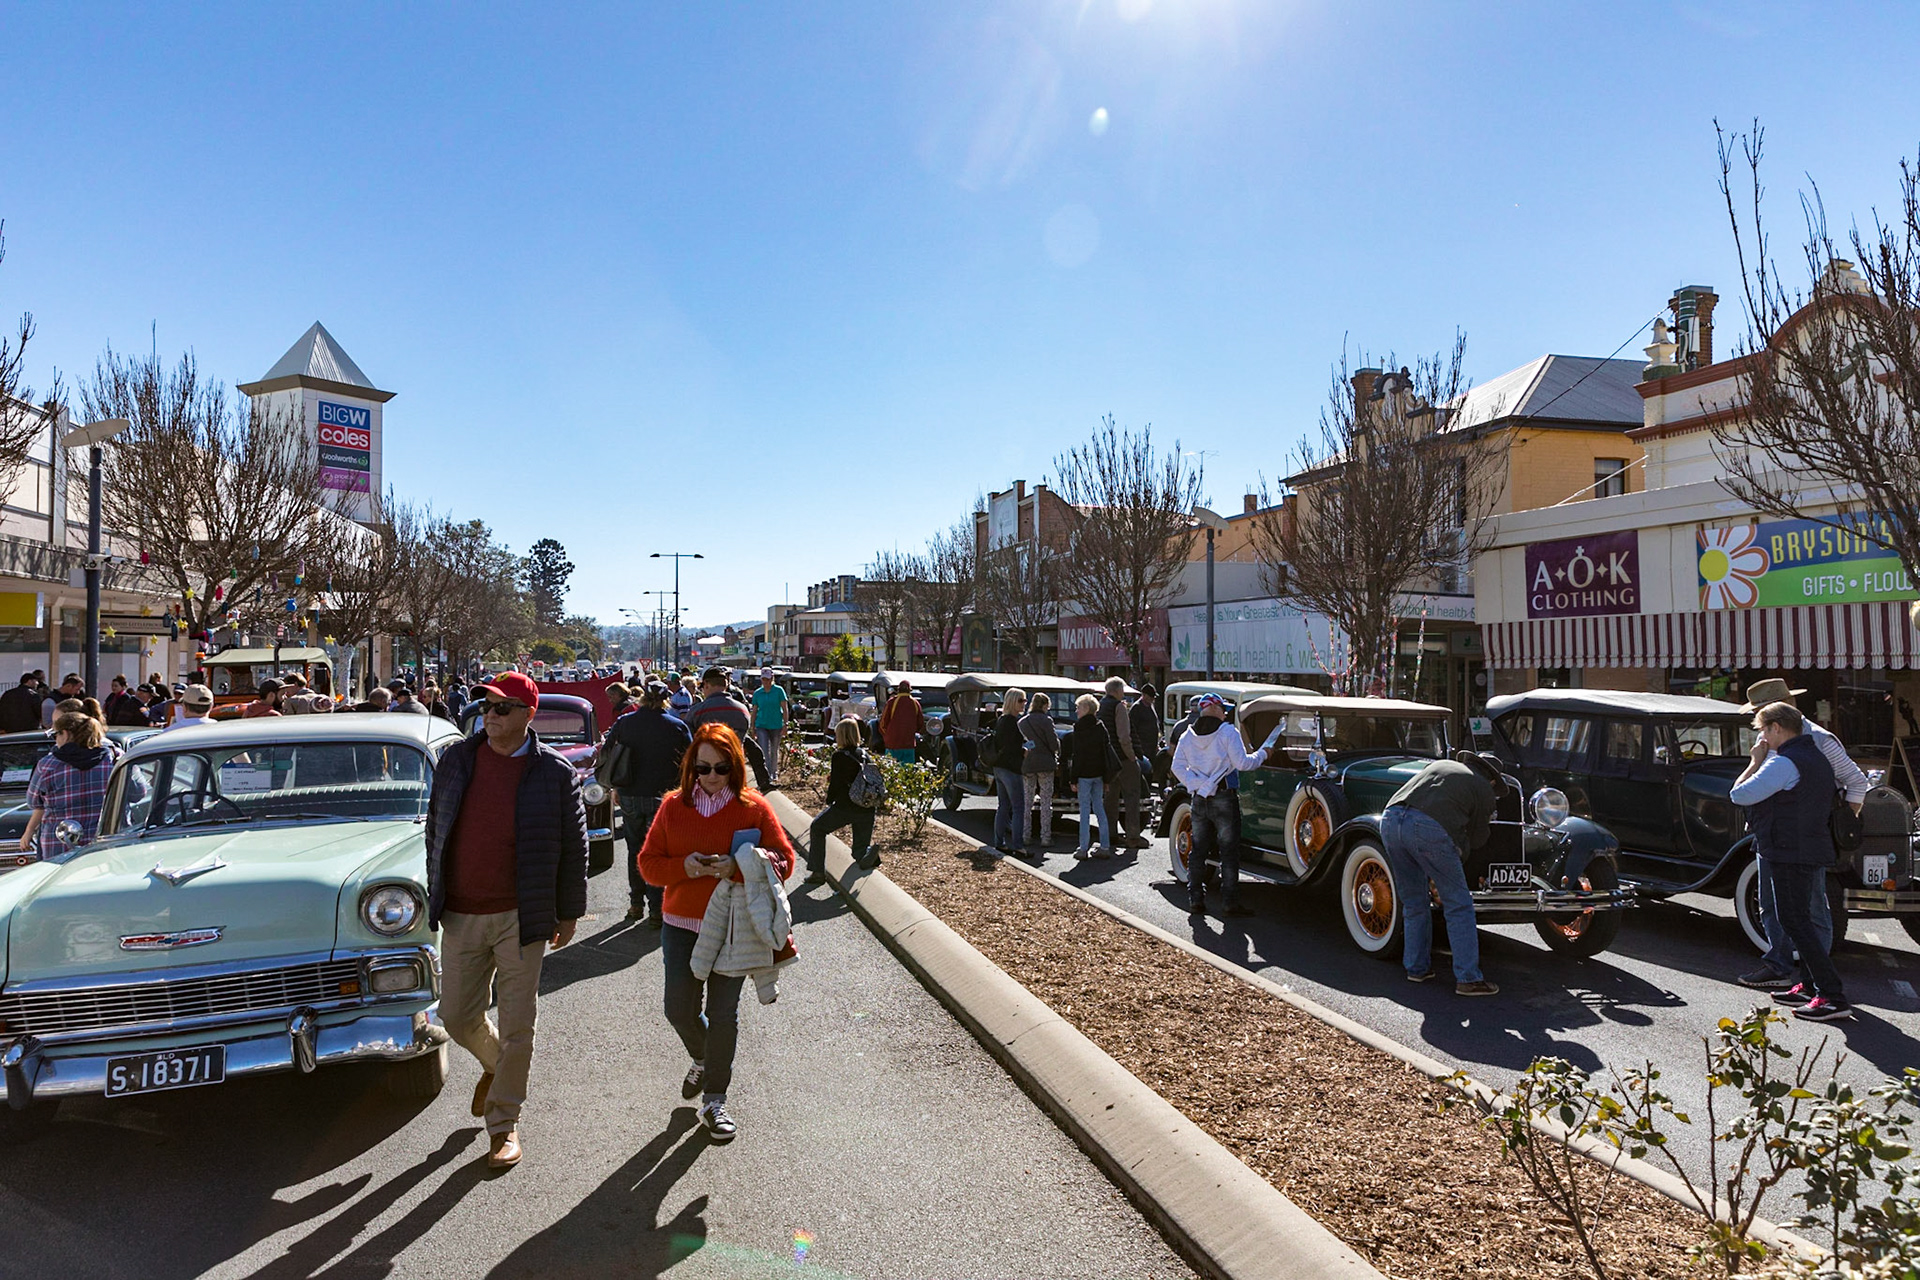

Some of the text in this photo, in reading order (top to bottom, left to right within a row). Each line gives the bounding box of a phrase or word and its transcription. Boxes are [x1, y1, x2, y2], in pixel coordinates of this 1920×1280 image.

[320, 427, 369, 447] coles
[1803, 575, 1845, 596] GIFTS
[1532, 588, 1635, 611] CLOTHING
[1224, 607, 1242, 620] Your
[1243, 604, 1279, 620] Greatest
[1281, 603, 1307, 617] Wea
[1437, 605, 1468, 618] health
[1192, 642, 1343, 669] nutional health & weal
[1491, 869, 1529, 883] ADA29
[1868, 868, 1884, 883] 861
